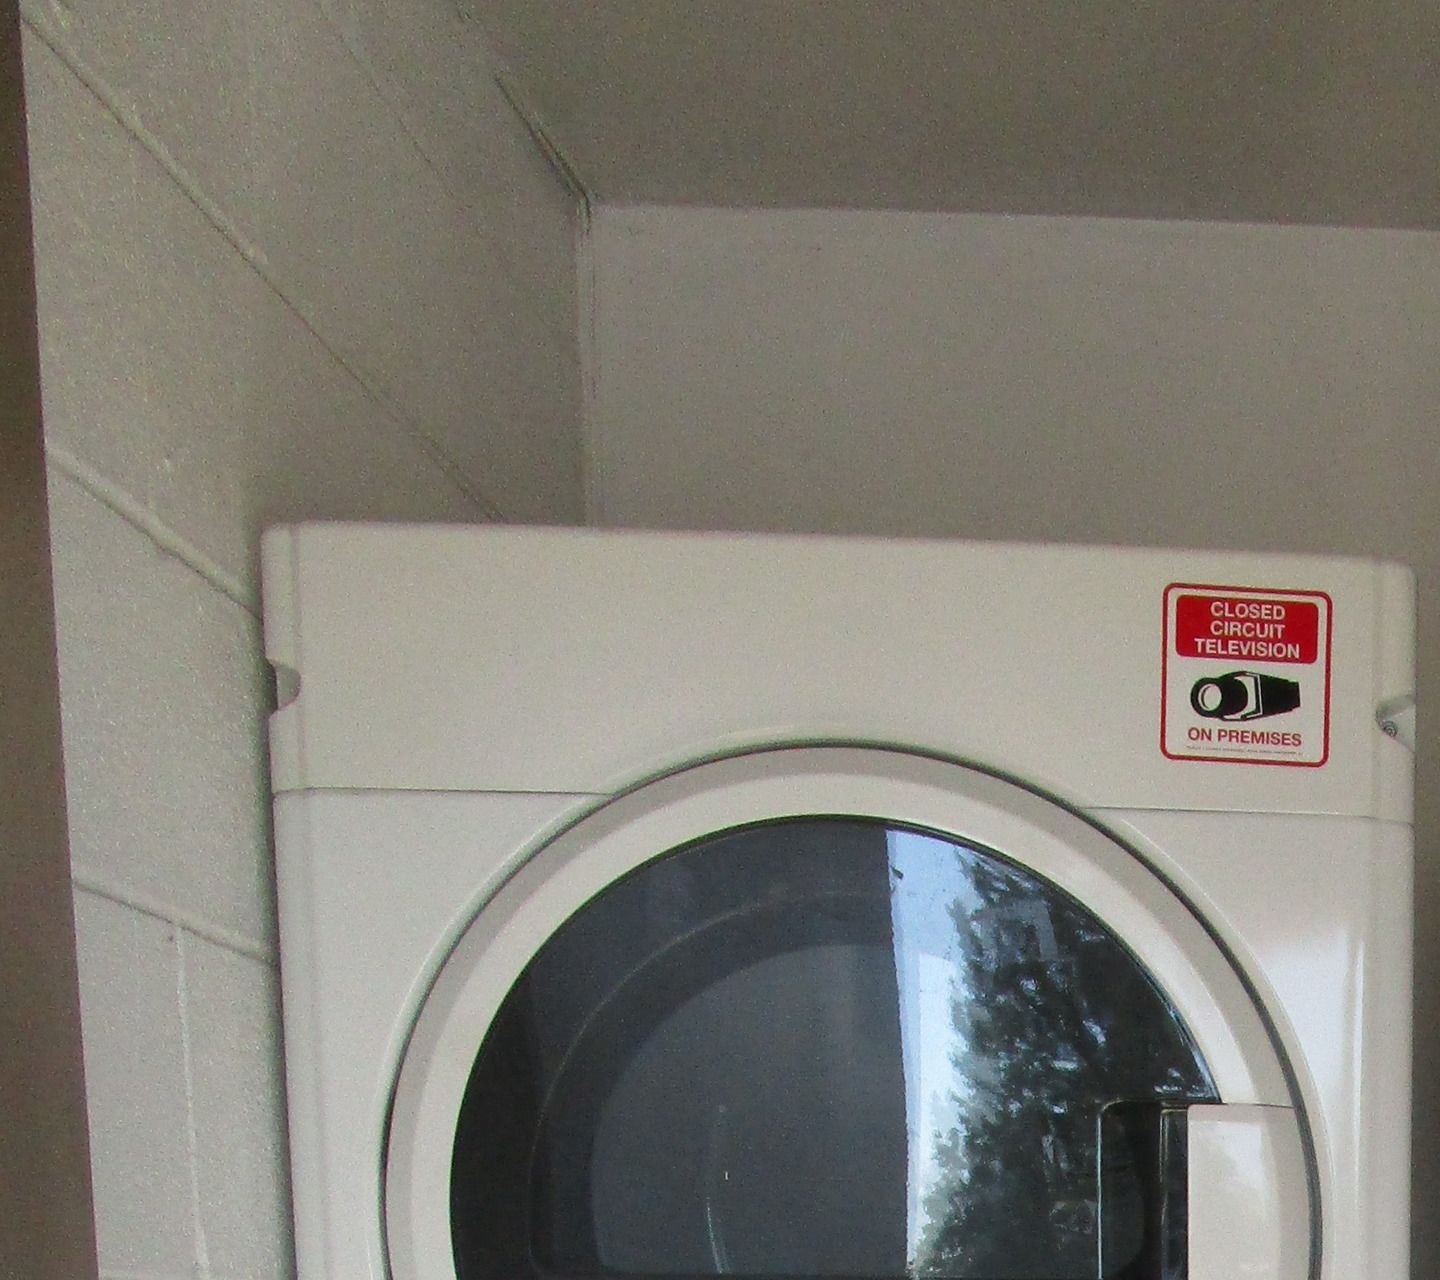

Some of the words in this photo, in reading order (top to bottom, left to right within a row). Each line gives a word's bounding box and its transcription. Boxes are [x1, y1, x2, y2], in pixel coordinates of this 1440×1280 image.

[1210, 601, 1286, 620] CLOSED
[1210, 620, 1286, 639] CIRCUIT
[1193, 637, 1300, 659] TELEVISION
[1187, 727, 1212, 742] ON
[1217, 728, 1302, 747] PREMISES
